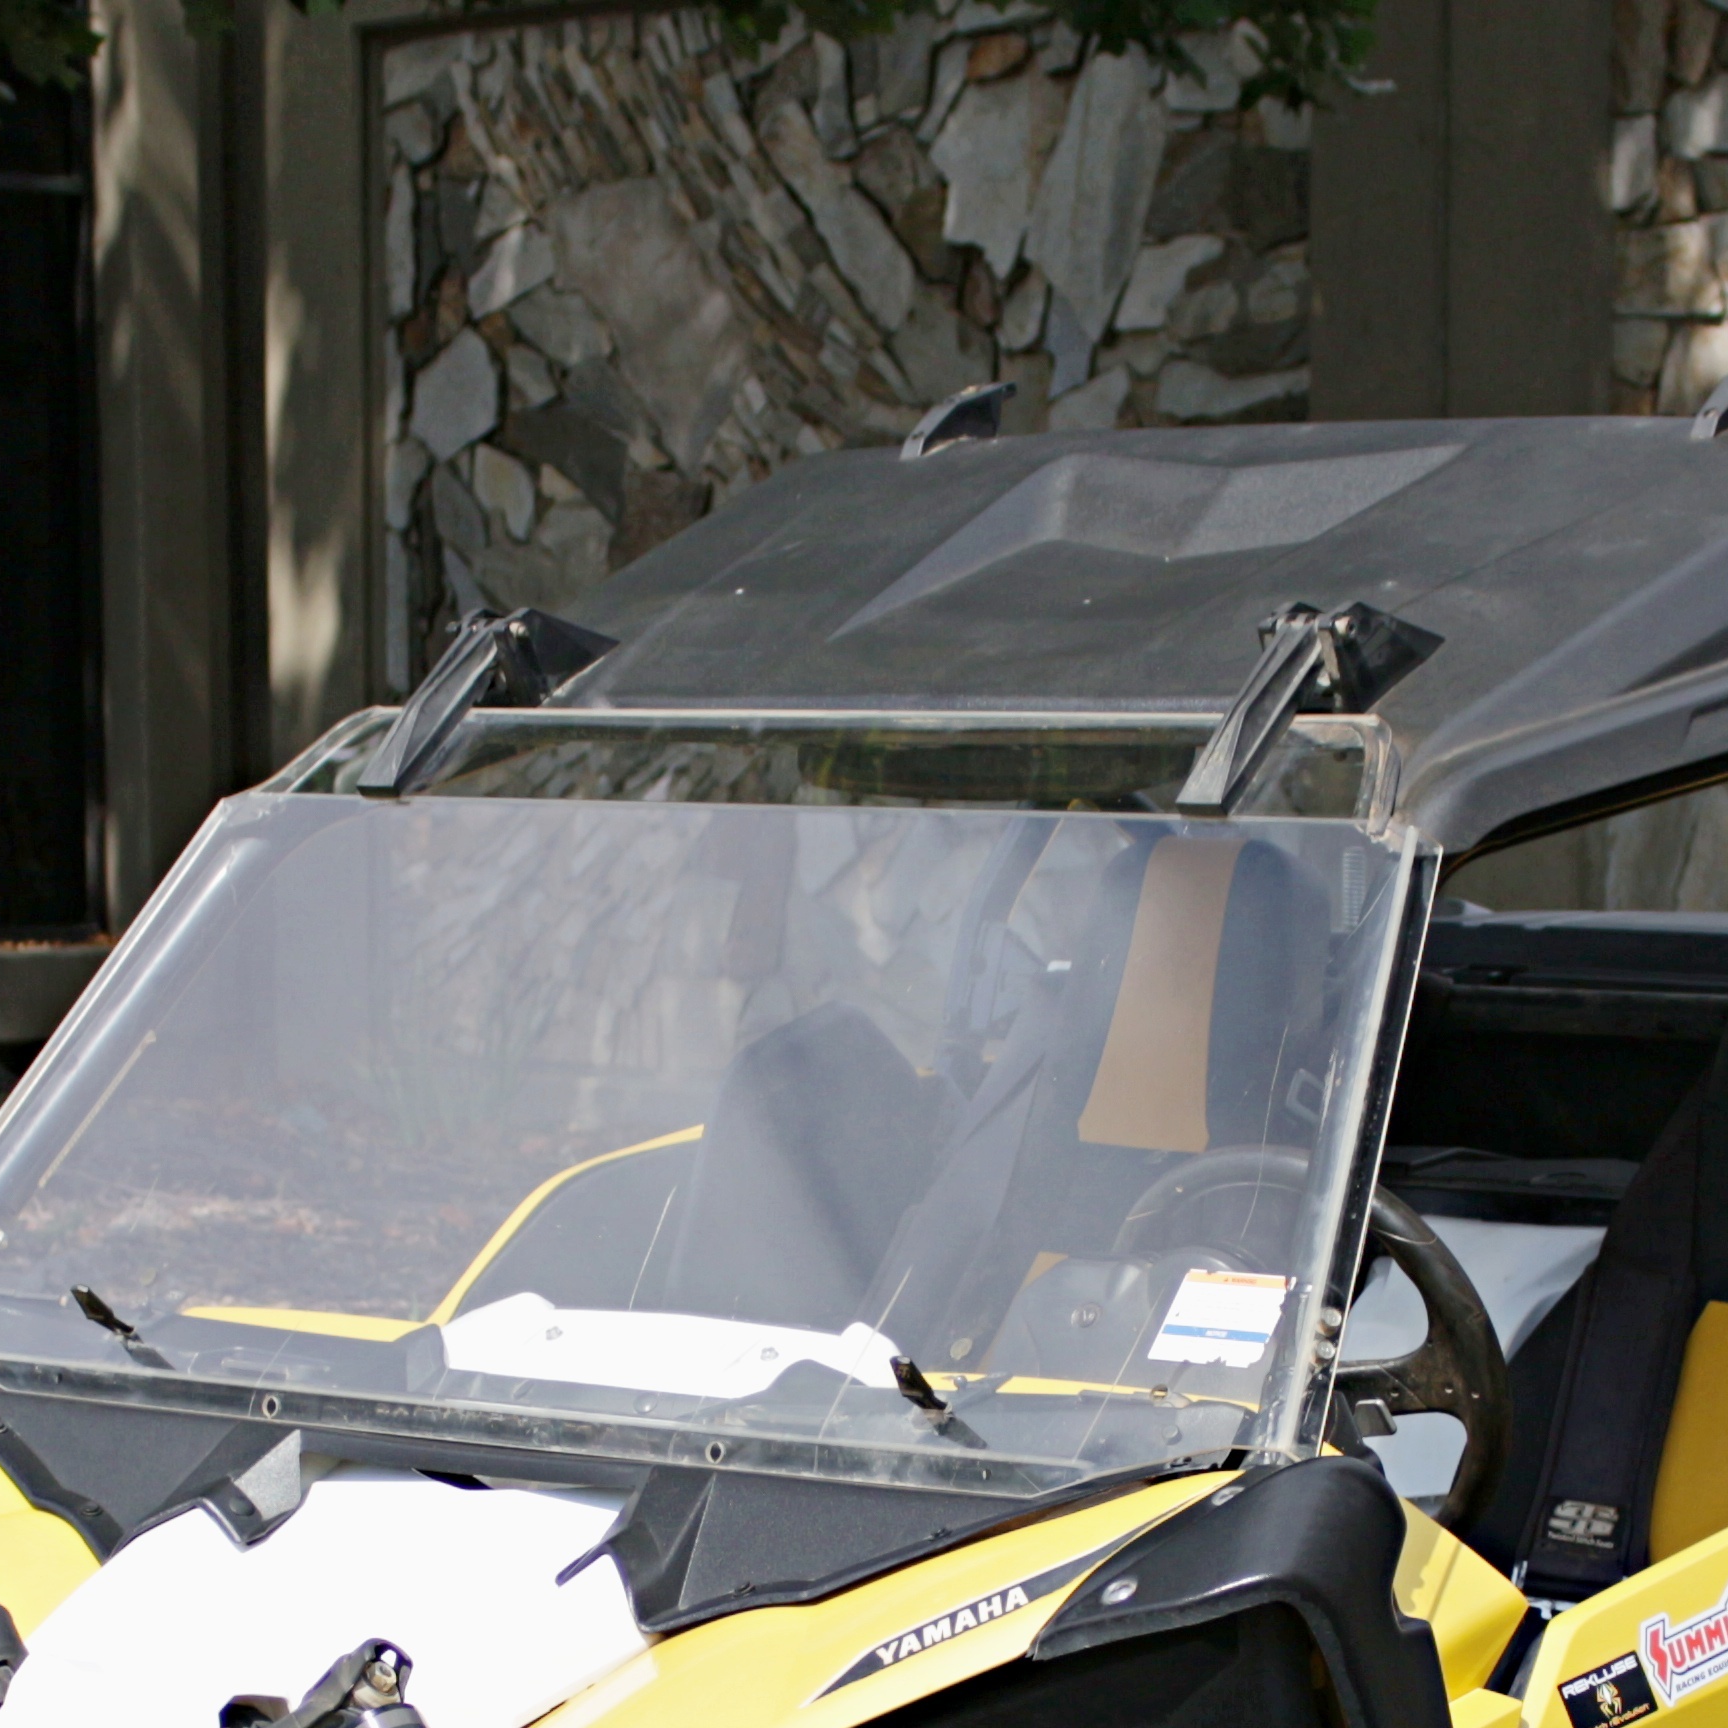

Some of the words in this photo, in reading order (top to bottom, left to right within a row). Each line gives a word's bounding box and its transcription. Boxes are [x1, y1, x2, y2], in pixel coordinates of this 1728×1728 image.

[875, 1586, 1030, 1666] YAMAHA
[1561, 1655, 1639, 1700] REKLUSE
[1676, 1671, 1706, 1693] RACING
